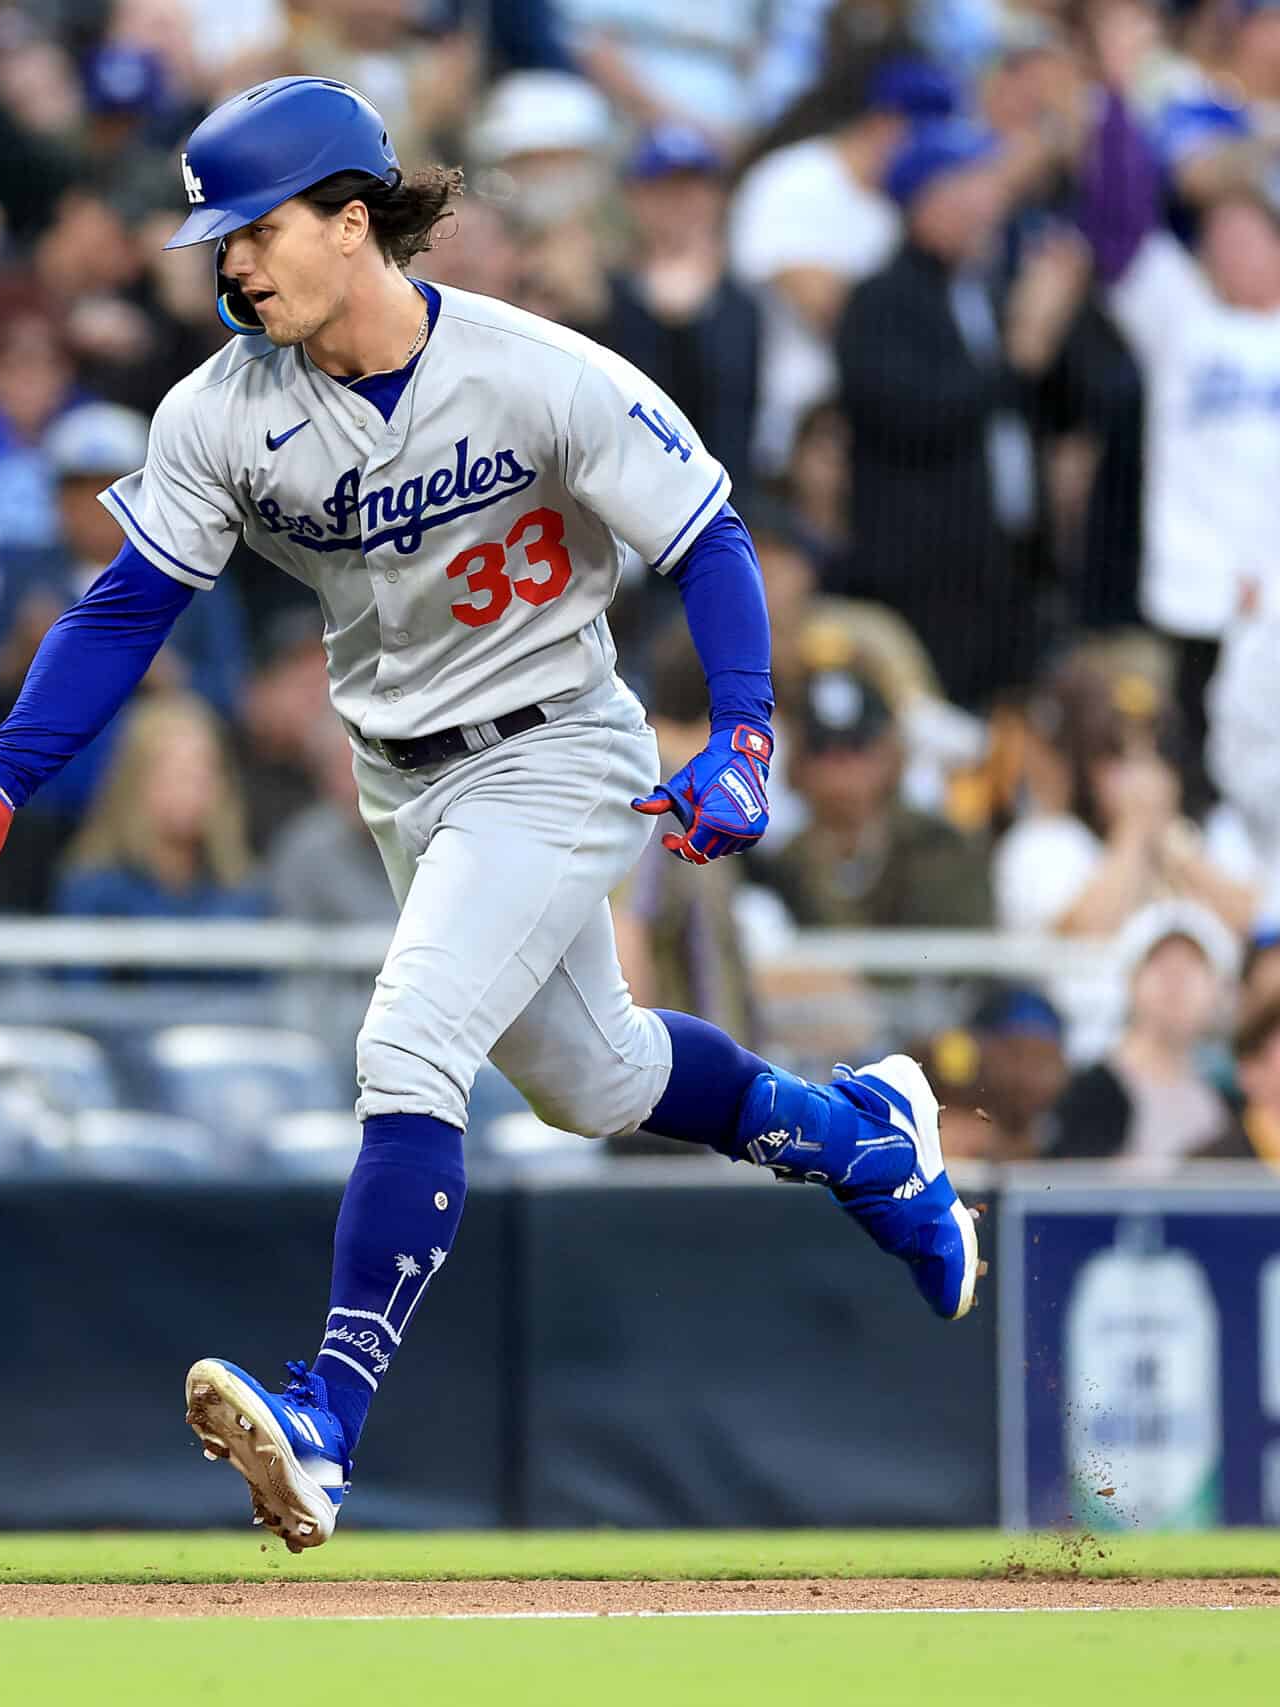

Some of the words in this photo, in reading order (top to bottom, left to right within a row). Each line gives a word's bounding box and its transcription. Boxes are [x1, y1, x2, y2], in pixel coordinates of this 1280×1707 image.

[627, 401, 694, 464] LA
[257, 497, 325, 539] Los
[322, 435, 537, 555] Angeles
[445, 506, 573, 628] 33
[758, 1128, 790, 1148] LA
